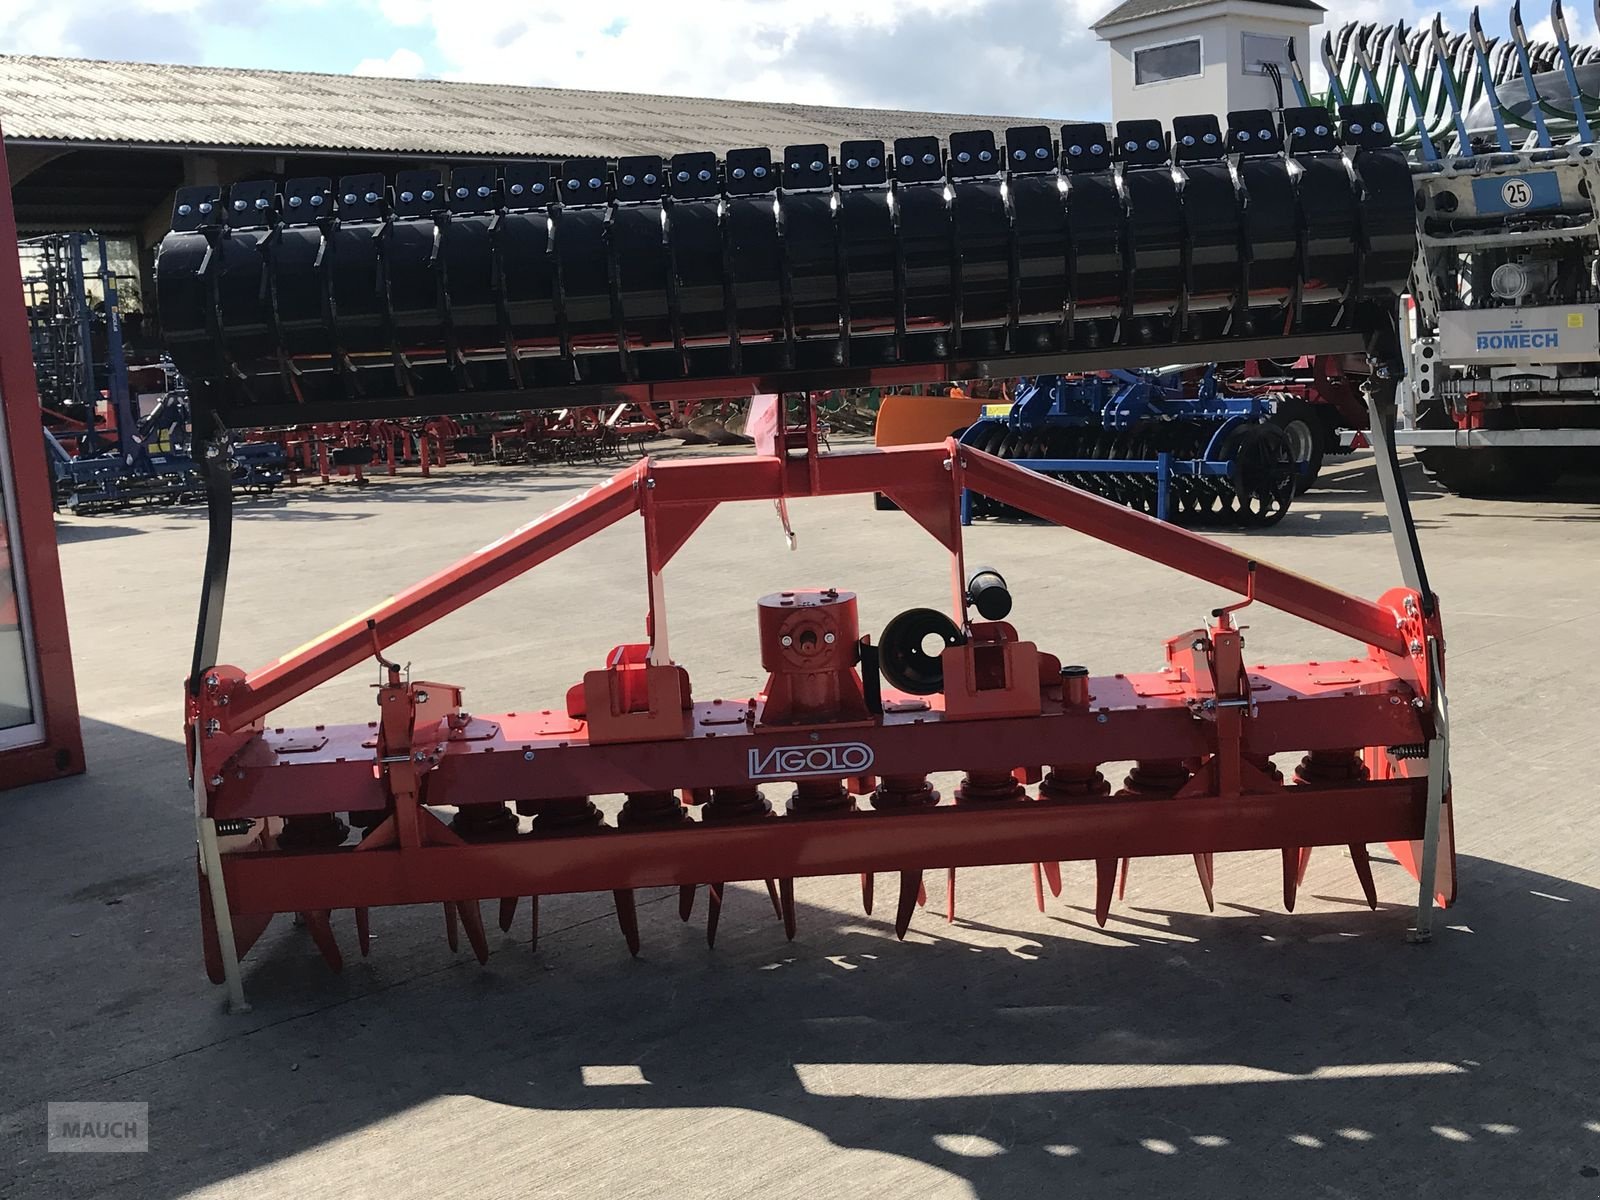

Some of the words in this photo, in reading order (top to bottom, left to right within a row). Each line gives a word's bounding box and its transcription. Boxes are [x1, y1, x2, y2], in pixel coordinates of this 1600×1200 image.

[1507, 184, 1527, 203] 25
[1477, 333, 1559, 350] BOMECH
[748, 742, 874, 778] VIGOLO
